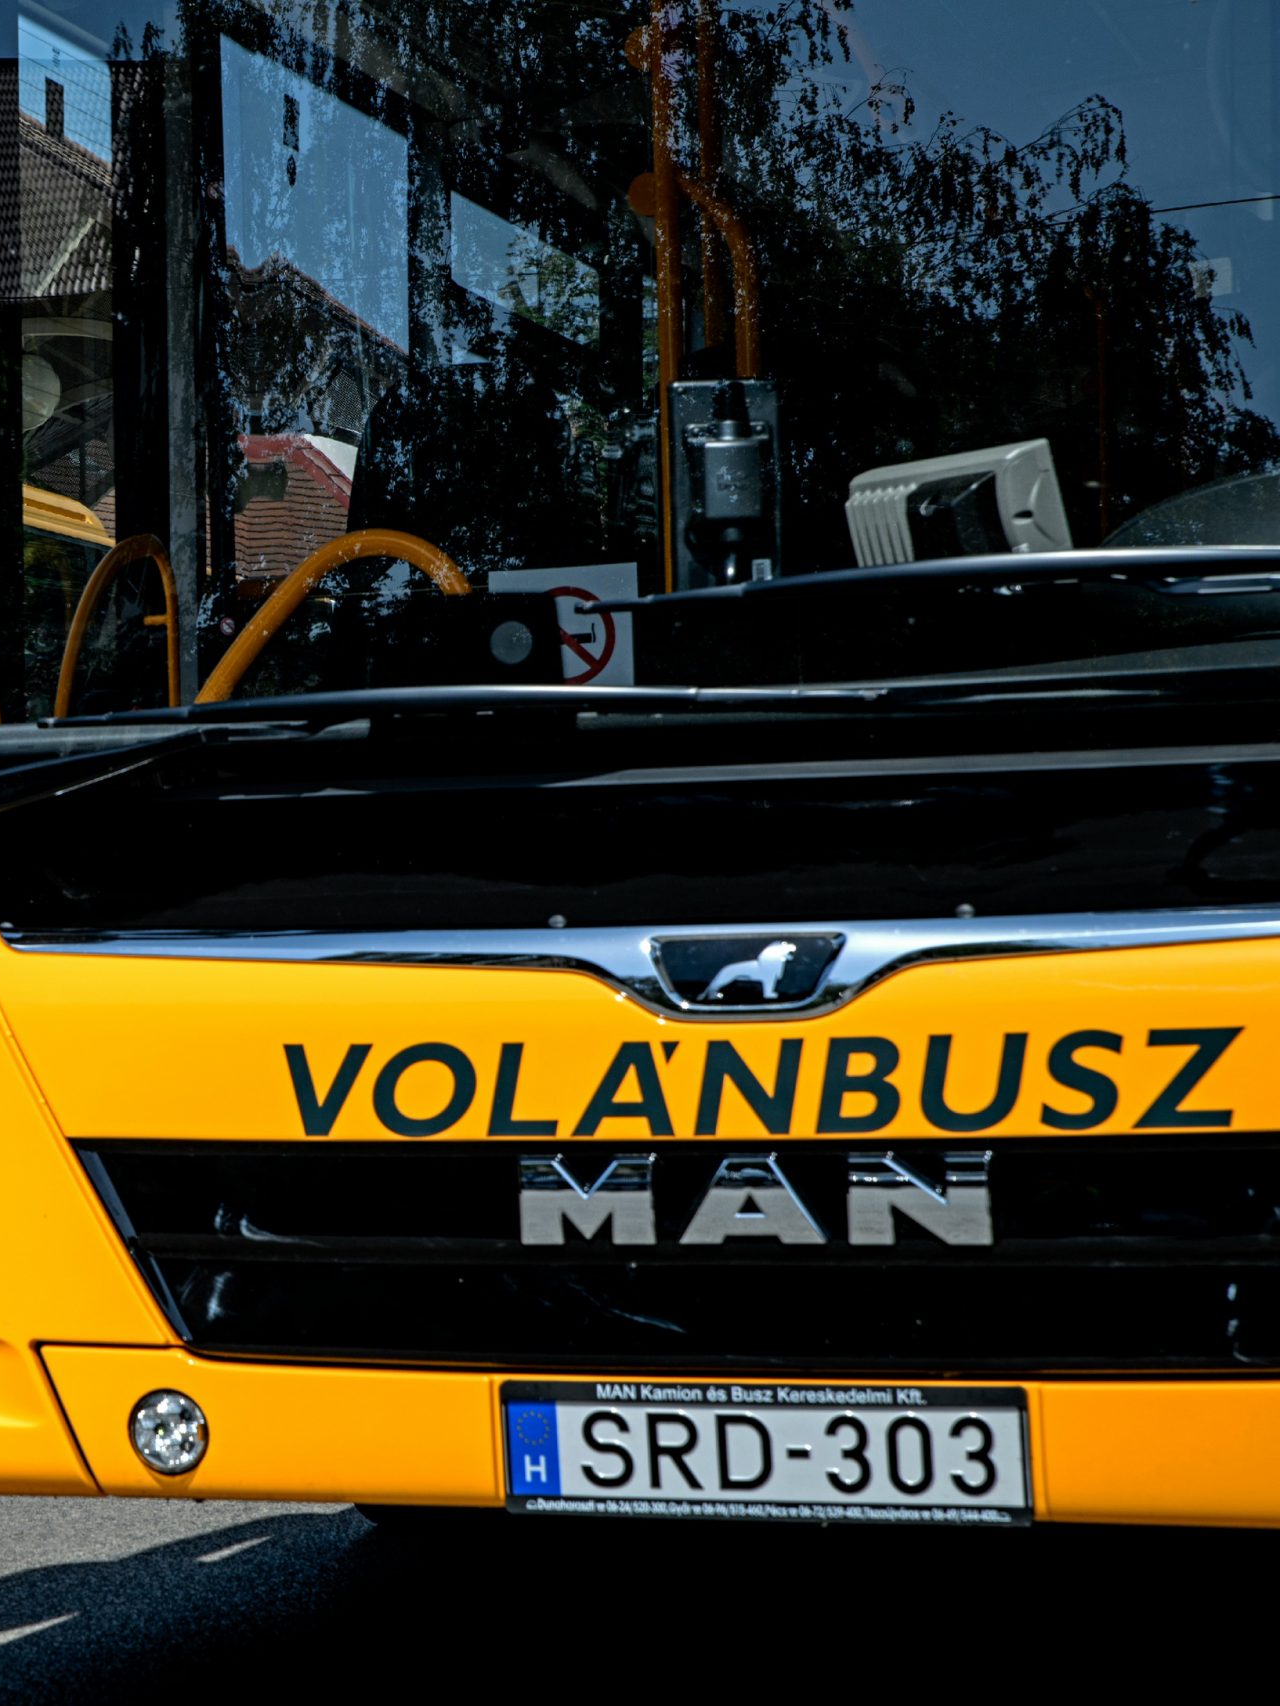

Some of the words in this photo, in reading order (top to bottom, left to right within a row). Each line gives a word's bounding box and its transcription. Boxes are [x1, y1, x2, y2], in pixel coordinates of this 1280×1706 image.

[282, 1026, 1246, 1138] VOLÁNBUSZ
[520, 1150, 995, 1247] MAN
[596, 1384, 636, 1400] MAN
[640, 1384, 702, 1401] Kamion
[706, 1385, 728, 1402] és
[731, 1385, 773, 1403] Busz
[777, 1386, 893, 1404] Kereskedelmi
[896, 1388, 928, 1406] Kft.
[524, 1455, 547, 1483] H
[580, 1409, 998, 1496] SRD-303
